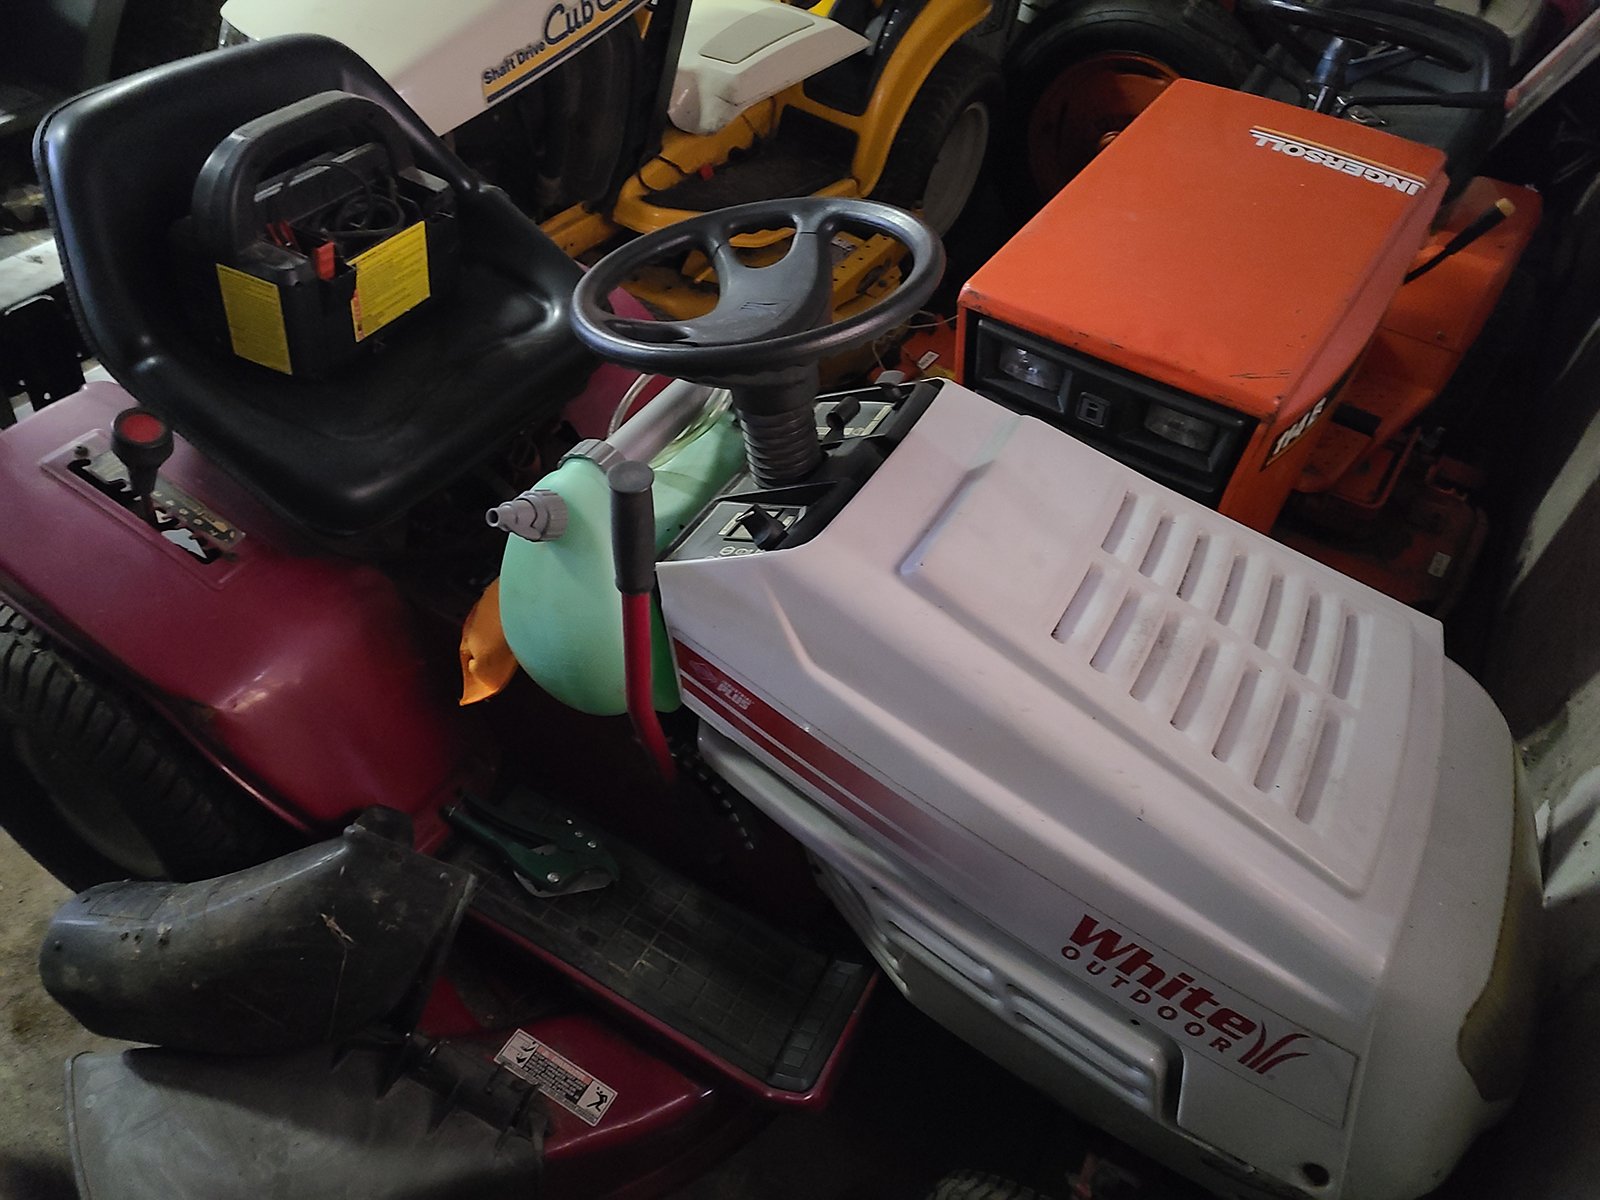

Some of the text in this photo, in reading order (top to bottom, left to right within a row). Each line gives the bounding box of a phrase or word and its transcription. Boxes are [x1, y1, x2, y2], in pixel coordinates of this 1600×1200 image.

[484, 59, 516, 84] Shaft
[517, 41, 546, 65] Drive
[544, 0, 594, 45] Cub
[1255, 136, 1420, 195] INGERSOLL
[1061, 945, 1233, 1053] OUTDOOR
[1069, 914, 1257, 1041] White
